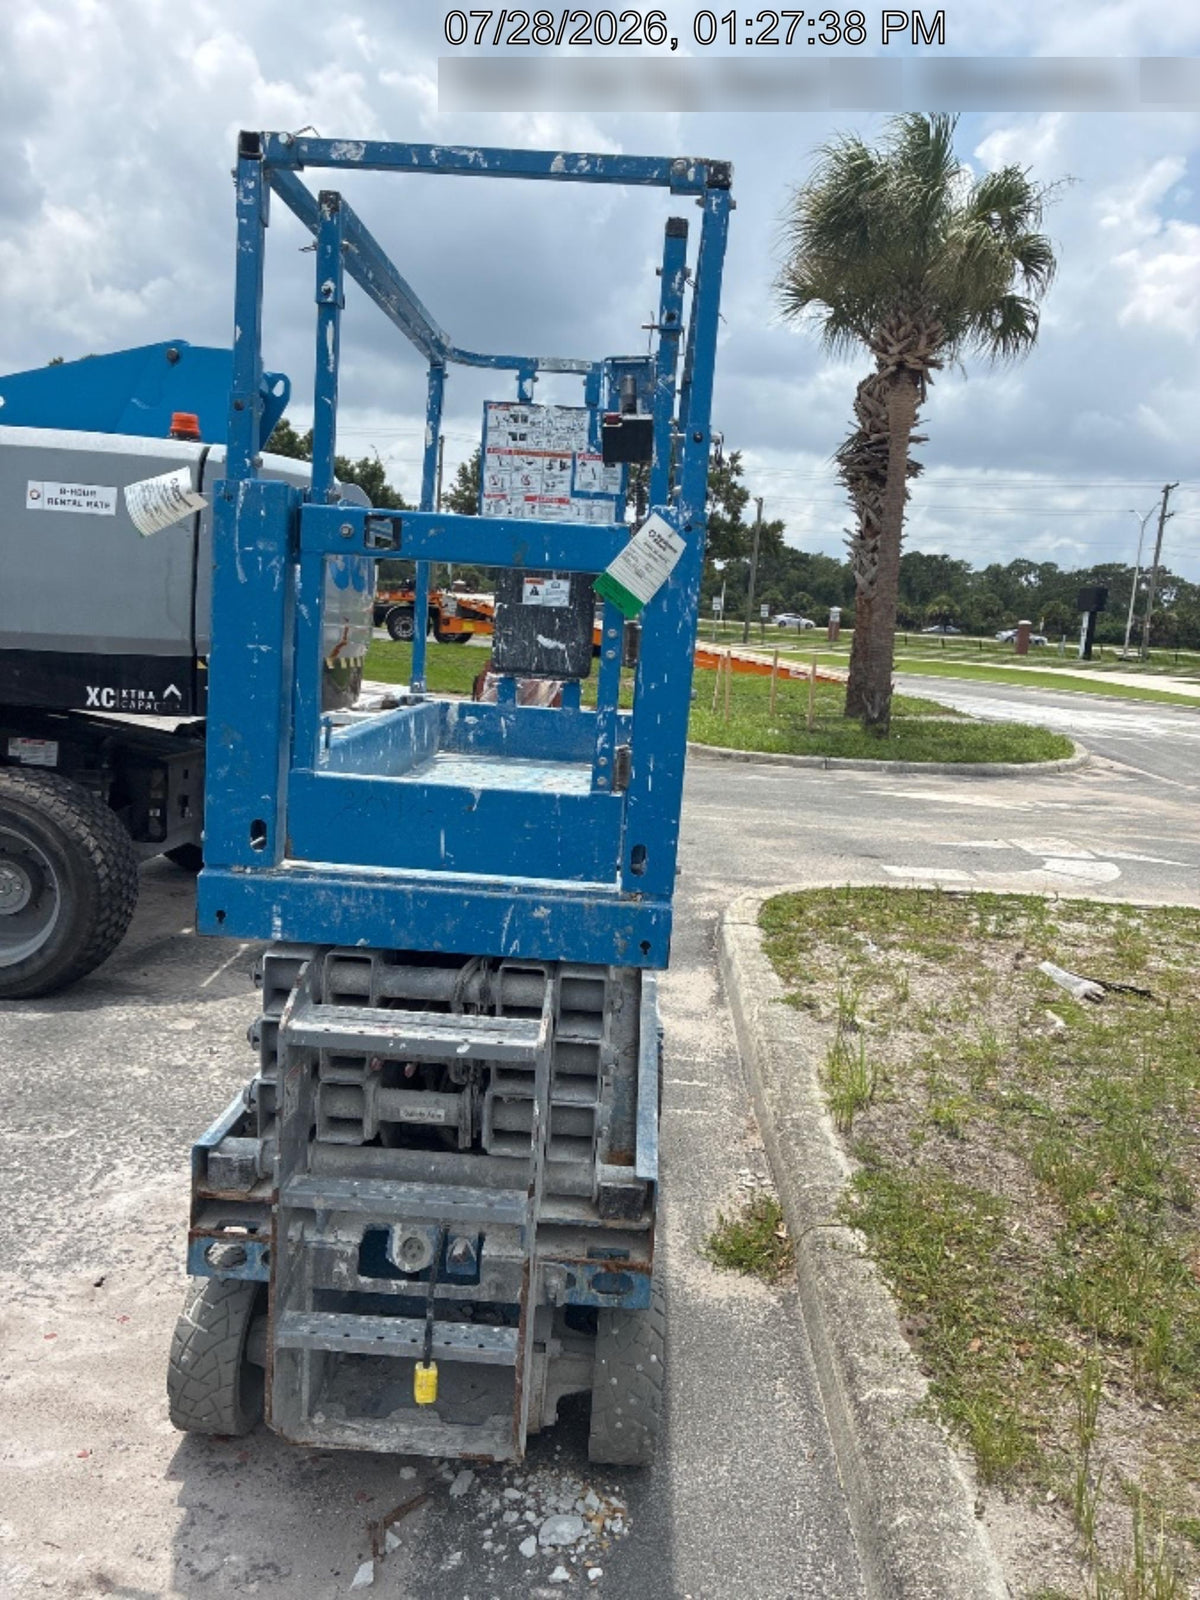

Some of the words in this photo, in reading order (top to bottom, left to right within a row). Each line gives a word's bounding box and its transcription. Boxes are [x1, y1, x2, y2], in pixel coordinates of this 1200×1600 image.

[47, 497, 83, 508] RENTAL
[86, 685, 116, 708] XC
[121, 689, 155, 700] XTRA
